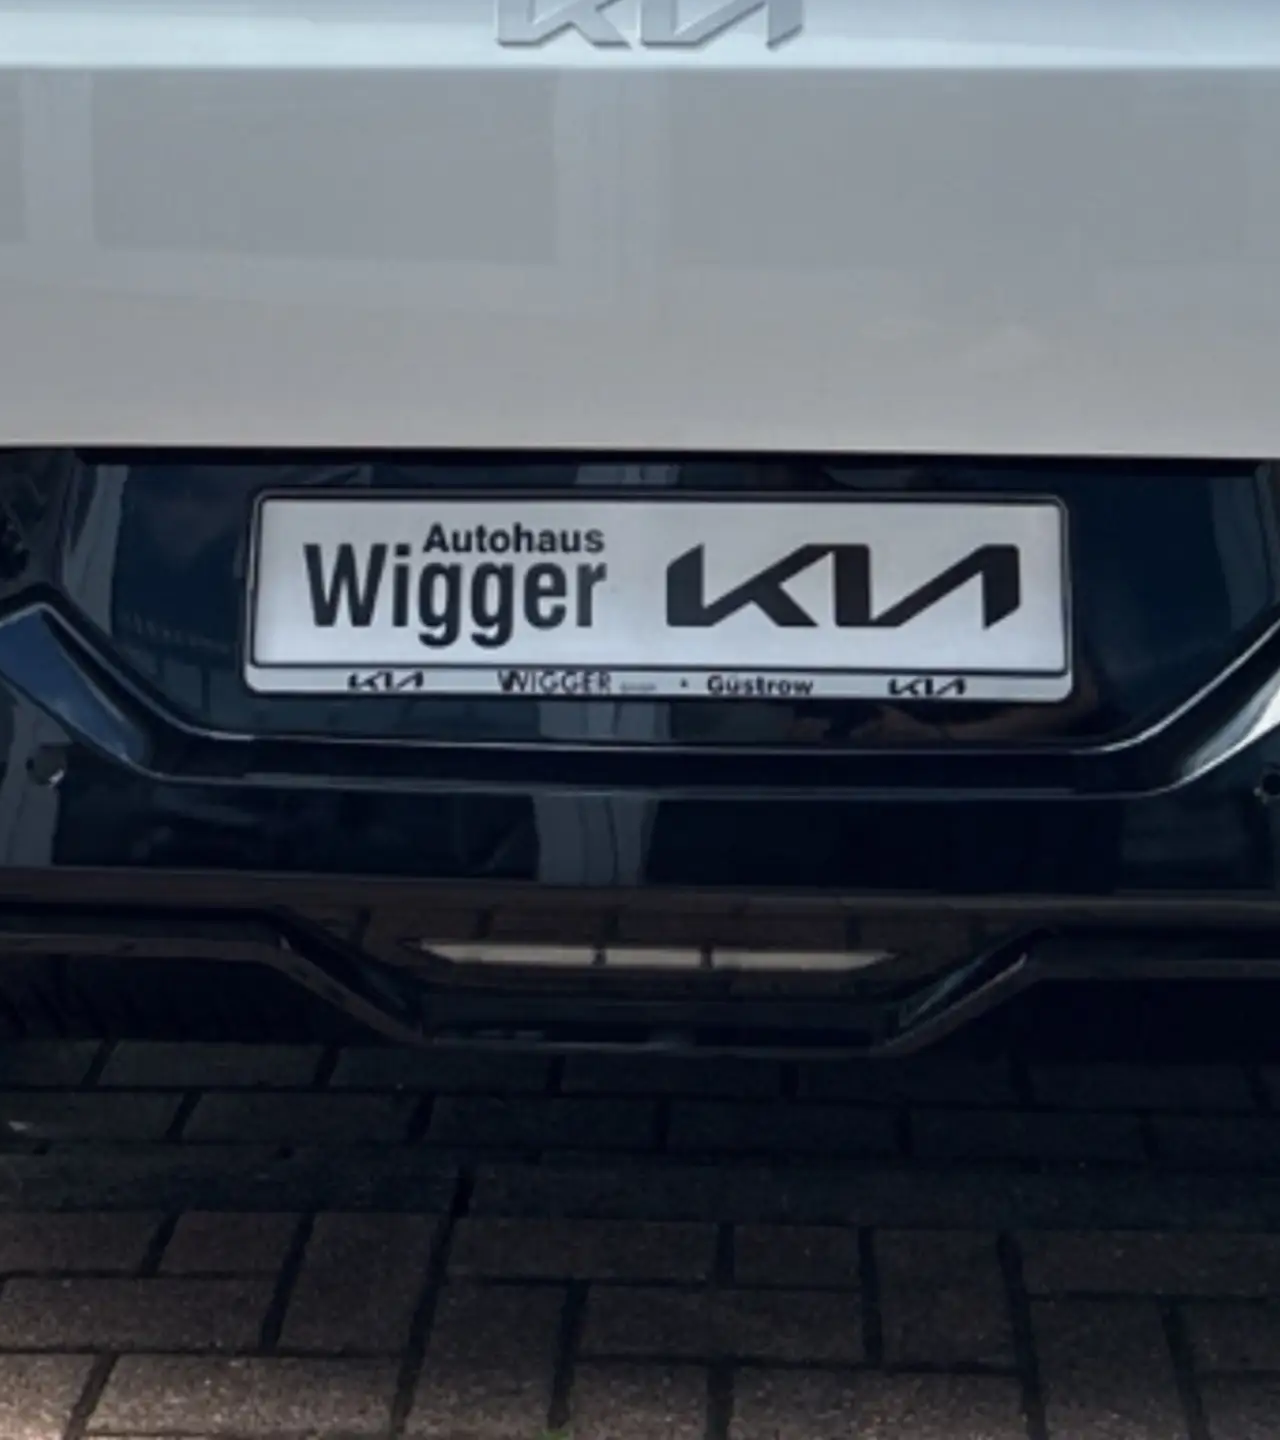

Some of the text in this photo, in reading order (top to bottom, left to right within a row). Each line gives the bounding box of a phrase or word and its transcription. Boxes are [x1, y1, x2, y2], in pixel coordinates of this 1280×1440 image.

[422, 522, 605, 553] Autohaus
[303, 543, 607, 648] Wigger
[666, 544, 1021, 628] KIA
[348, 669, 424, 692] KIA
[498, 669, 612, 694] WIGGER
[888, 677, 967, 698] KIA
